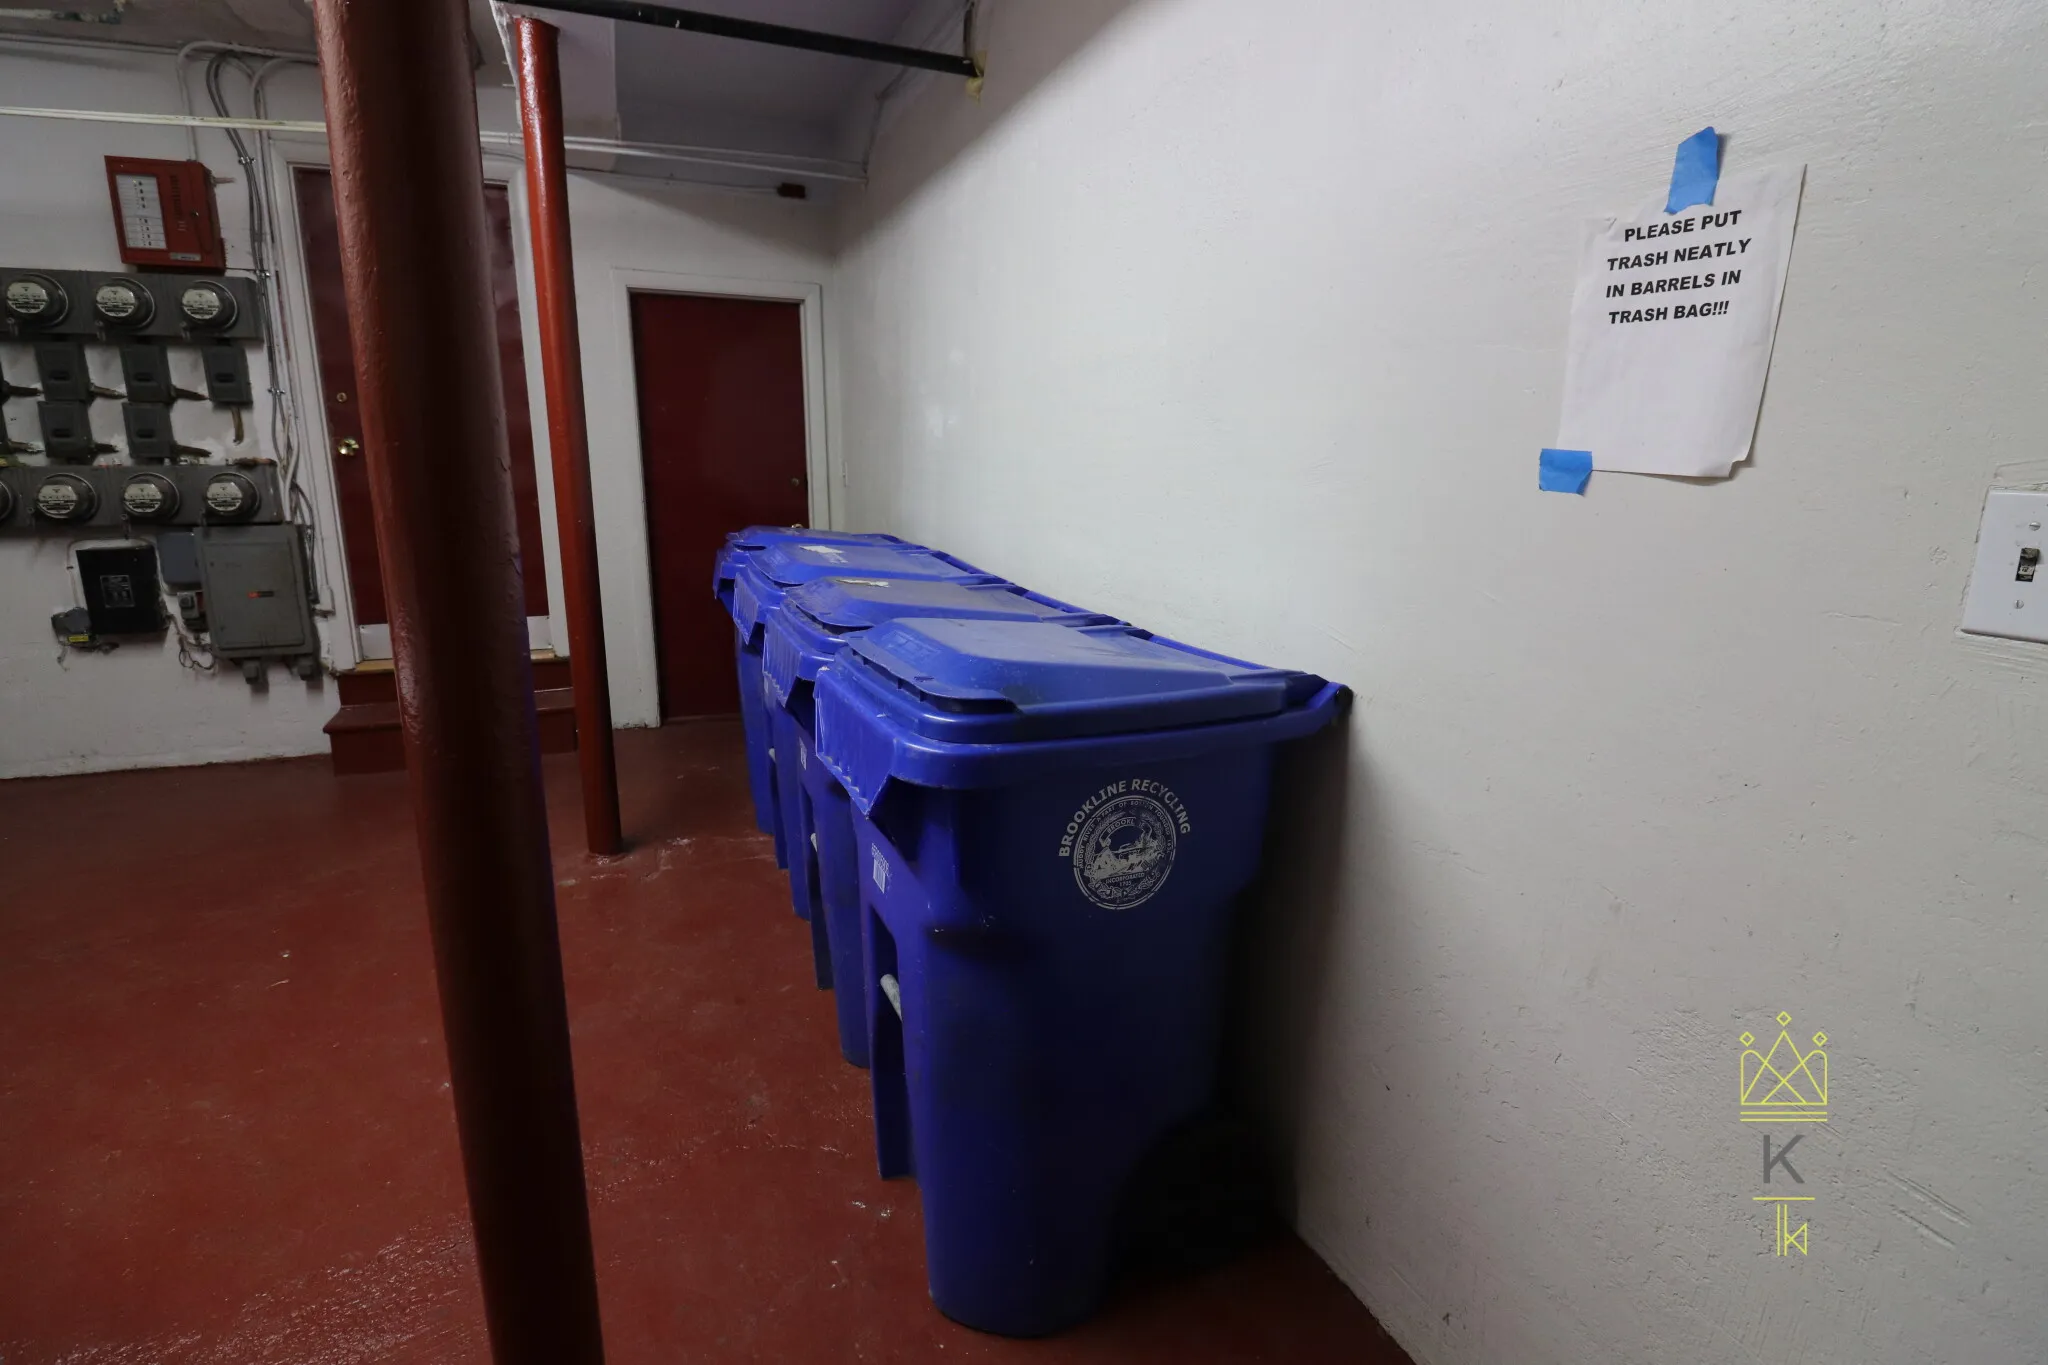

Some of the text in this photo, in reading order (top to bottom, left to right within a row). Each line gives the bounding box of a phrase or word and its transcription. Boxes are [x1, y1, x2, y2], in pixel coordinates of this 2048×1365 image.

[1624, 210, 1742, 242] PLEASE PUT
[1607, 238, 1751, 271] TRASH NEATLY
[1605, 269, 1742, 298] IN BARRELS IN
[1608, 301, 1729, 325] TRASH BAG!!!
[1058, 778, 1191, 857] BROOKLINE RECYCLING
